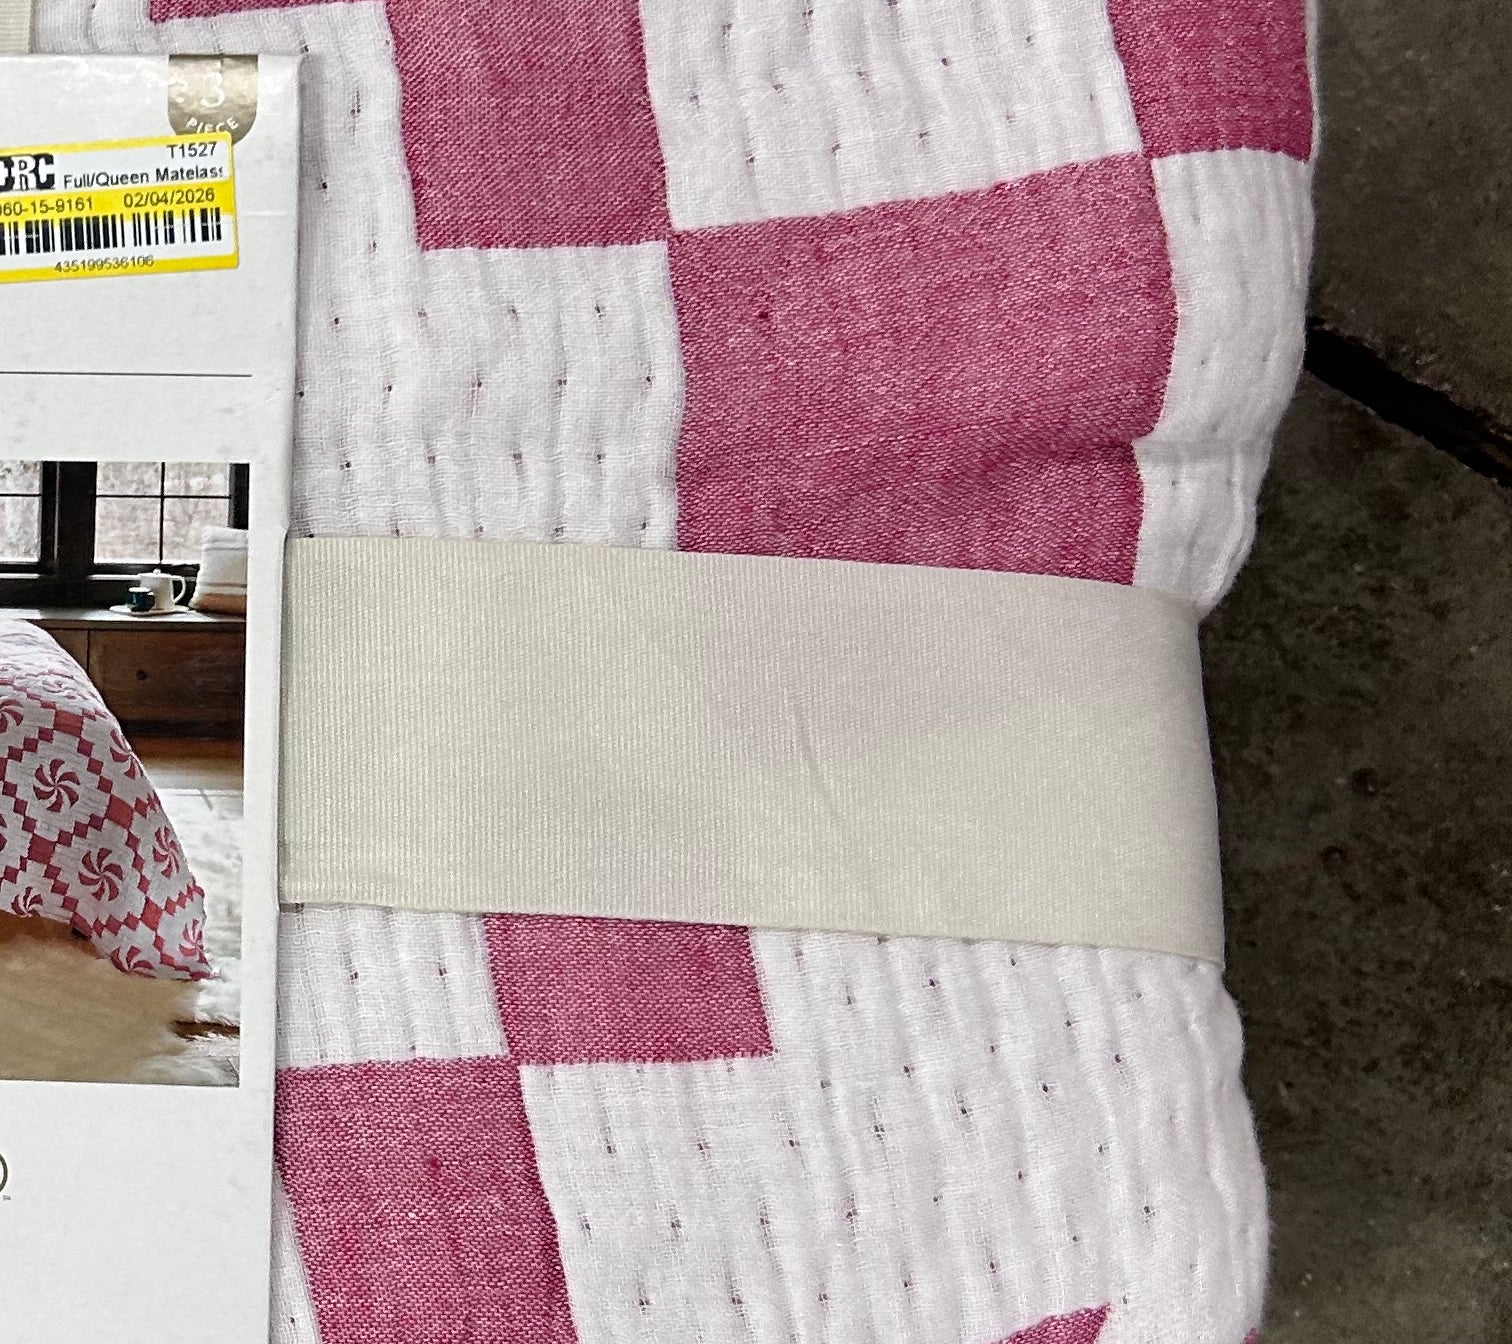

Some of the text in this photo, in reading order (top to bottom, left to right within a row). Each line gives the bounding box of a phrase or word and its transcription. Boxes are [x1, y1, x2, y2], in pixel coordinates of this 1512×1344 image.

[200, 71, 225, 108] 3
[166, 141, 217, 159] T1527
[64, 170, 150, 189] Full/Queen
[123, 187, 215, 208] 02/04/2026
[55, 255, 155, 273] 435199536106
